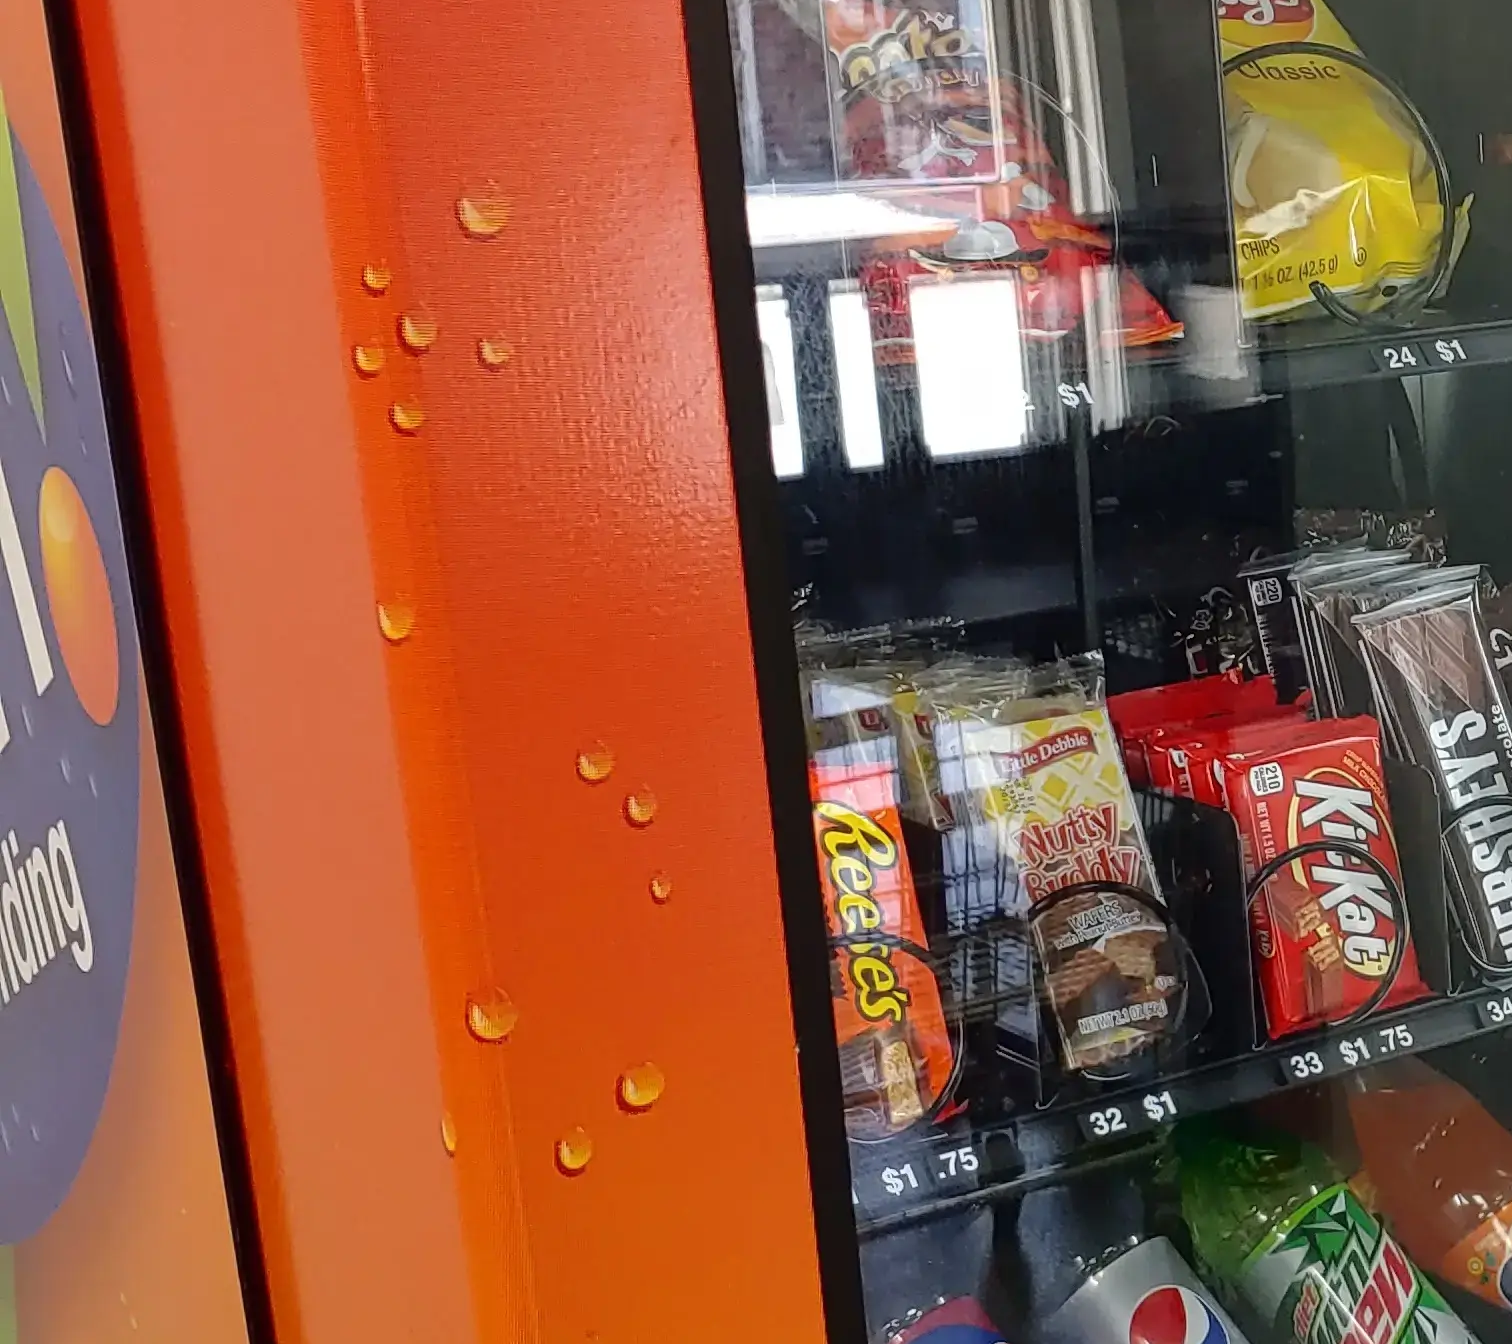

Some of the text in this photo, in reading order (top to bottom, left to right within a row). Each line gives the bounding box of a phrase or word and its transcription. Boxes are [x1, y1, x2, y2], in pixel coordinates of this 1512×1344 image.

[1236, 58, 1341, 82] Classic
[1240, 237, 1280, 261] CHIPS
[1298, 255, 1339, 284] (42.5 g)
[1383, 339, 1468, 370] 24 $1
[1057, 382, 1094, 409] $1
[1265, 578, 1281, 602] 220
[1038, 732, 1090, 760] Debbie
[1265, 765, 1281, 790] 210
[1014, 802, 1120, 868] Nutty
[1020, 846, 1141, 903] Buddy
[1068, 902, 1123, 932] WAFERS
[1290, 1027, 1415, 1078] 33 $1 .75
[1089, 1091, 1179, 1136] 32 $1
[881, 1147, 980, 1195] $1 .75
